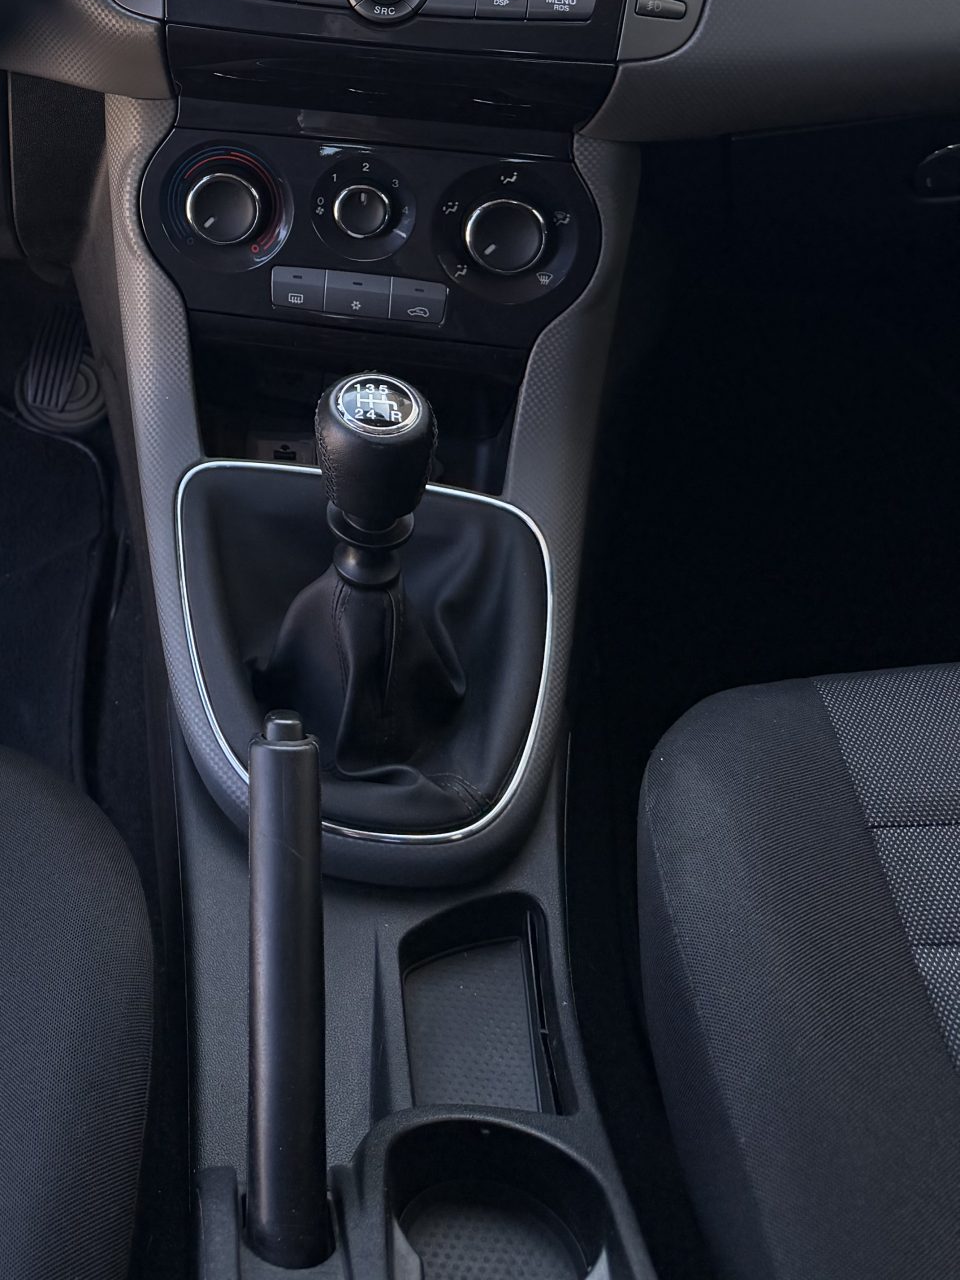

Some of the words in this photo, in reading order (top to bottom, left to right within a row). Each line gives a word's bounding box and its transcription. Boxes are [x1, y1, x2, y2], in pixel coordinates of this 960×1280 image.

[373, 5, 397, 16] SRC
[553, 4, 570, 13] RDS
[362, 162, 370, 172] 2
[332, 173, 337, 182] 1
[391, 178, 399, 188] 3
[402, 205, 409, 215] 4
[353, 383, 361, 393] 1
[365, 383, 375, 393] 3
[378, 384, 388, 395] 5
[354, 408, 364, 419] 2
[366, 408, 377, 420] 4
[390, 410, 402, 423] R
